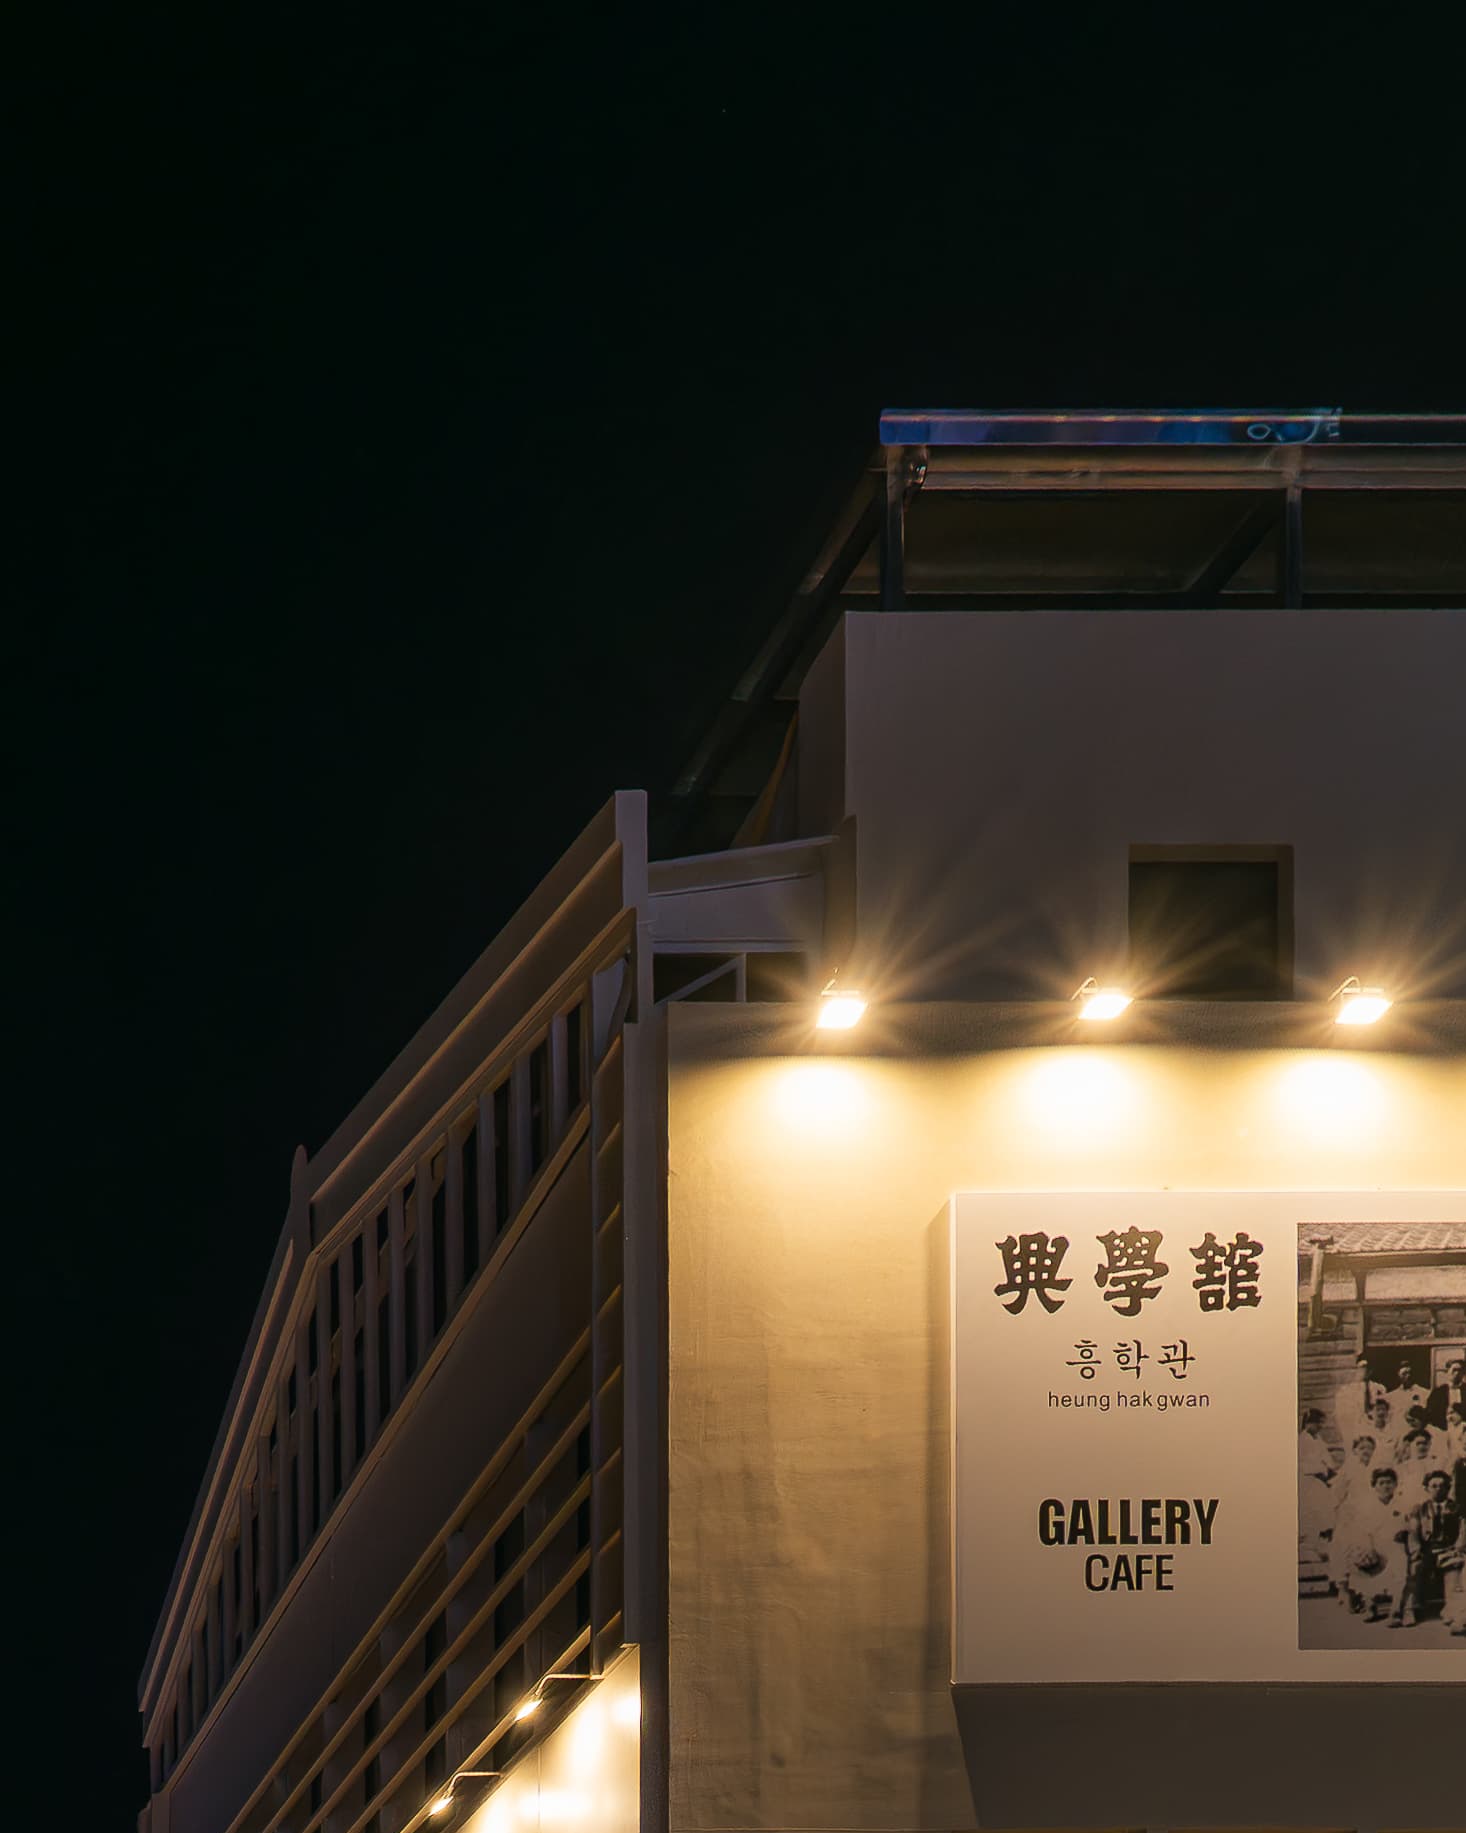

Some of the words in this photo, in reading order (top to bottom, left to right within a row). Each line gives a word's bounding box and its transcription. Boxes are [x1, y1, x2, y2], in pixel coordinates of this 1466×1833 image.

[1065, 1339, 1196, 1380] 흥학관
[1047, 1391, 1110, 1411] heung
[1116, 1391, 1153, 1408] hak
[1157, 1394, 1210, 1411] gwan
[1038, 1498, 1219, 1546] GALLERY
[1084, 1554, 1174, 1592] CAFE
